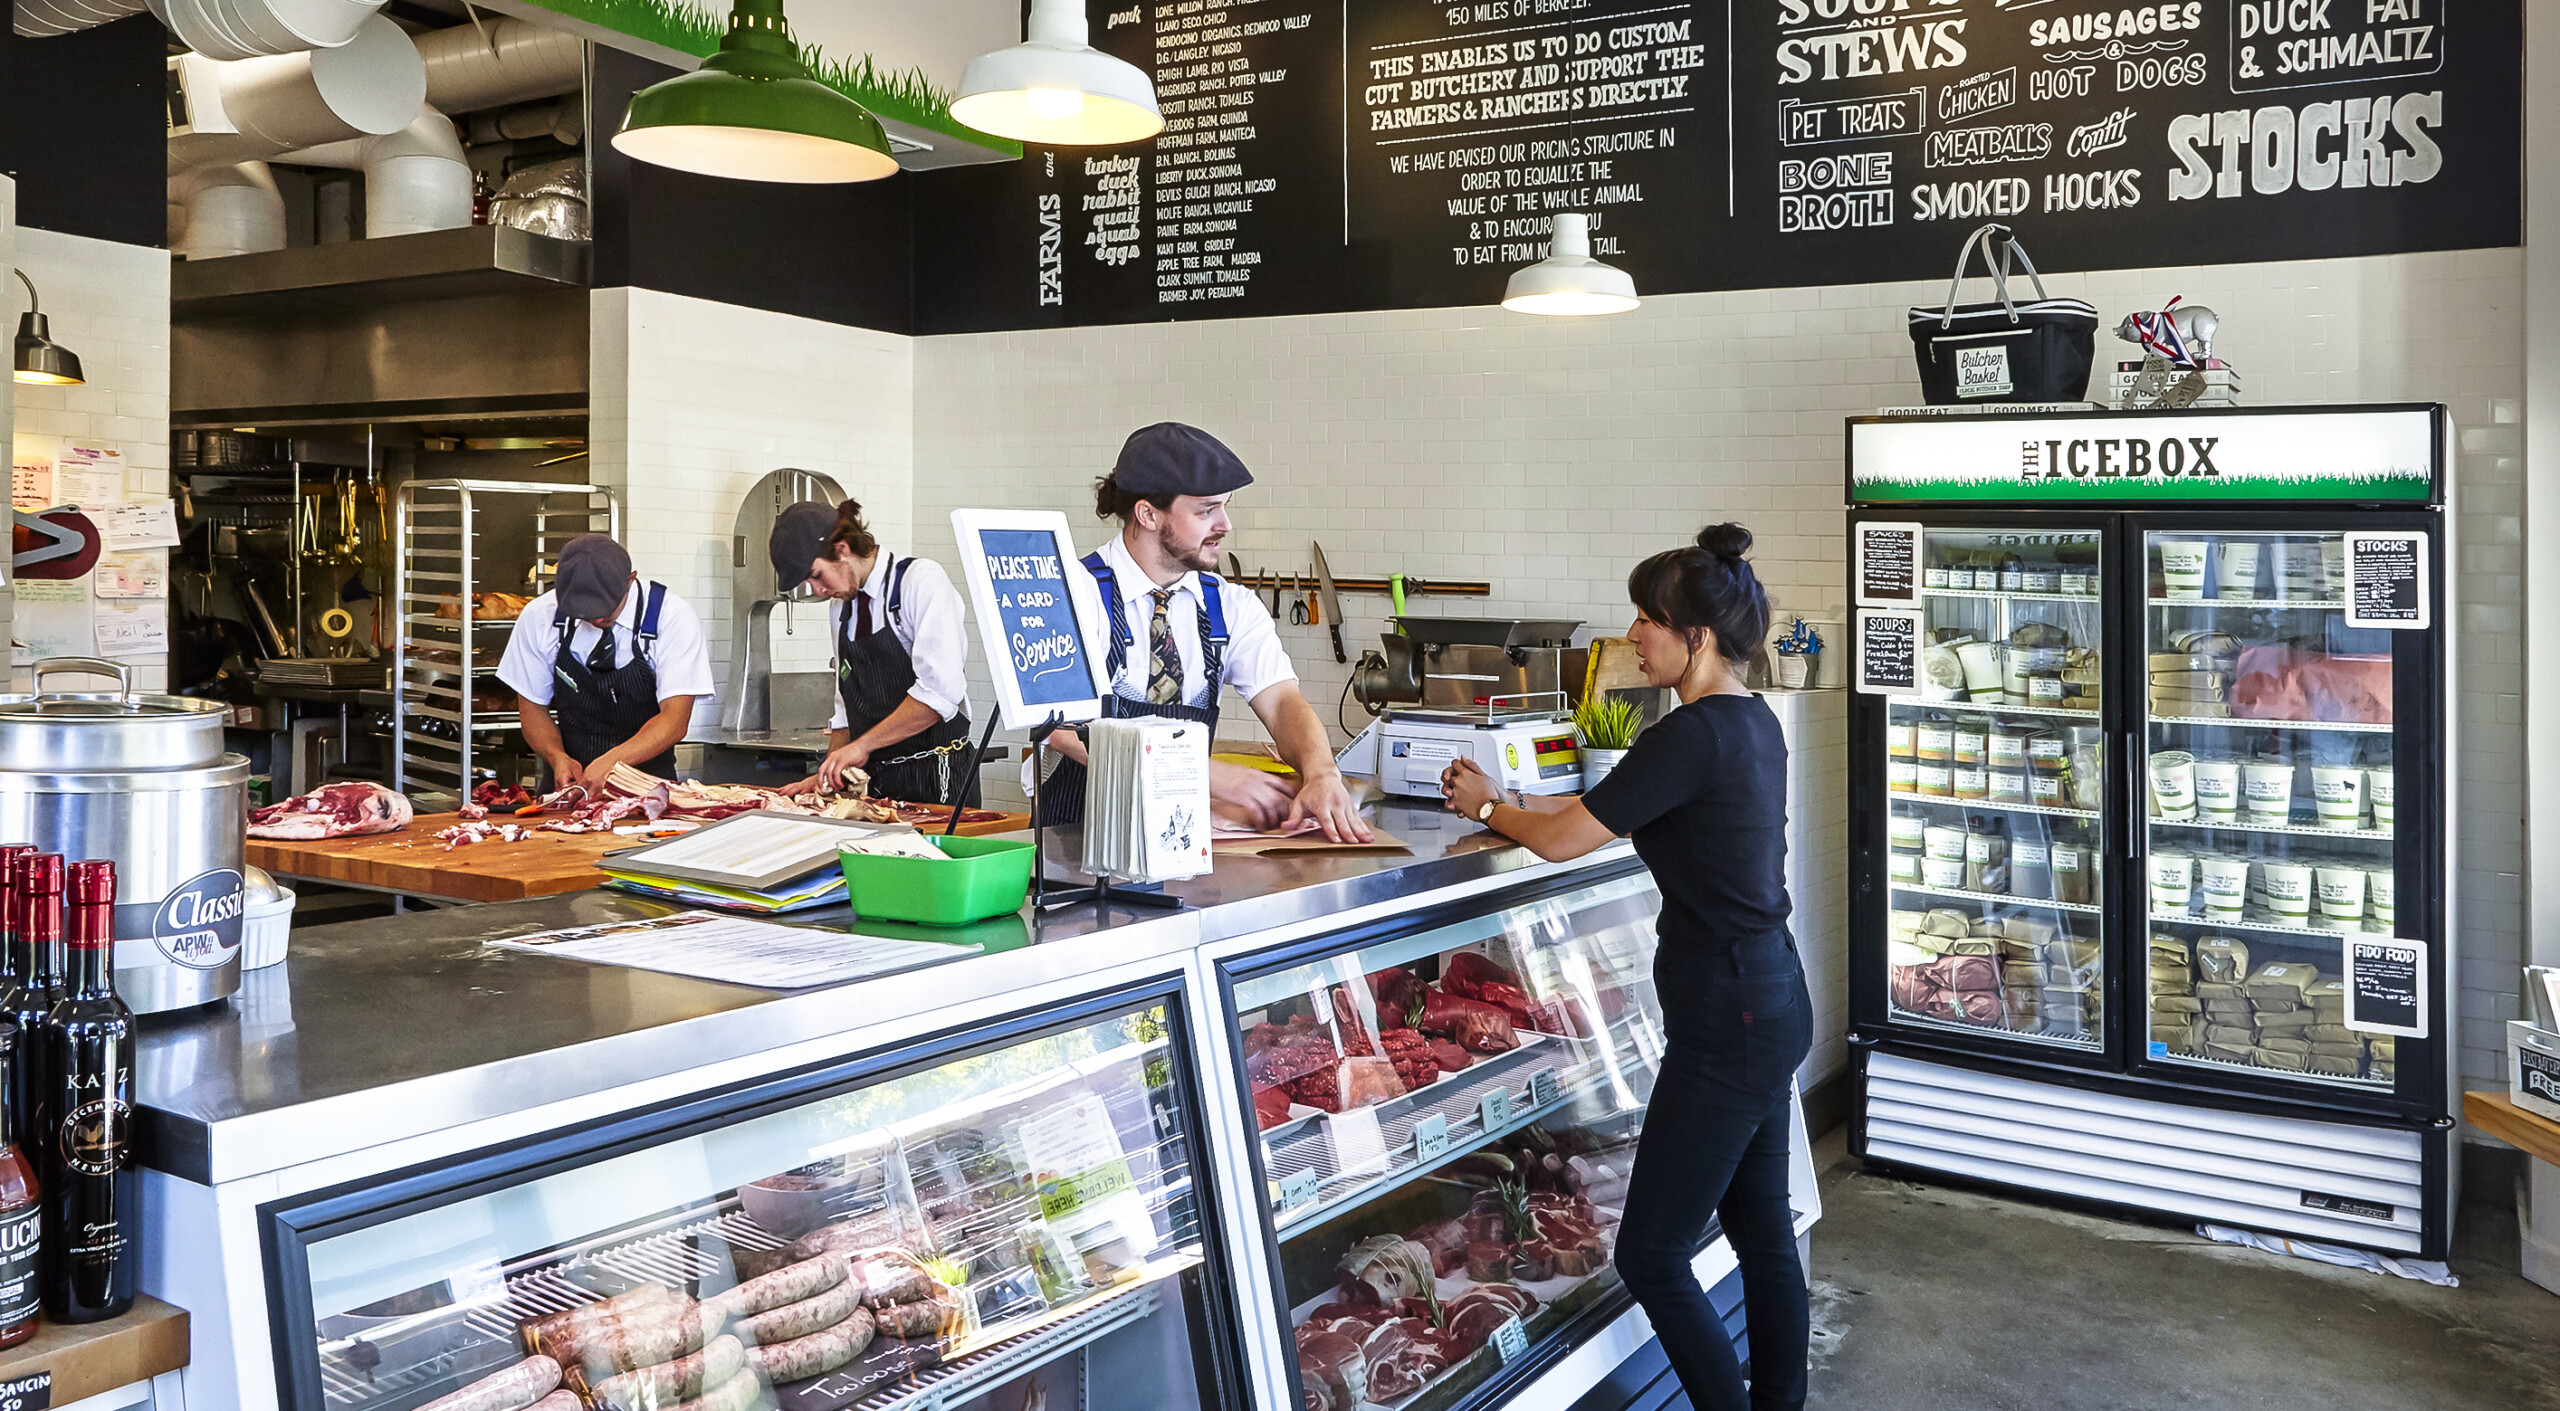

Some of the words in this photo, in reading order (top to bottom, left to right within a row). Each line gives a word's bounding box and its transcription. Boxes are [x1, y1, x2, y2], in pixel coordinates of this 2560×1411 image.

[1156, 6, 1174, 18] LONE
[1177, 2, 1203, 15] WILLOW
[1445, 7, 1470, 26] 150
[1474, 2, 1508, 22] MILES
[1514, 0, 1530, 18] OF
[1846, 14, 1897, 30] AND
[2240, 0, 2332, 40] DUCK
[1156, 20, 1180, 33] LLANO
[1156, 32, 1198, 48] MENDOCINO
[1244, 20, 1280, 36] REDWOOD
[1283, 14, 1312, 30] VALLEY
[2028, 3, 2202, 46] SAUSAGES
[1212, 42, 1242, 57] NICASIO
[1370, 56, 1414, 80] THIS
[1420, 43, 1508, 74] ENABLES
[1513, 39, 1536, 61] US
[1541, 35, 1568, 58] TO
[1574, 31, 1602, 56] DO
[1608, 19, 1692, 50] CUSTOM
[1776, 17, 1969, 85] STEWS
[2239, 46, 2264, 80] &
[2276, 26, 2435, 76] SCHMALTZ
[1157, 66, 1182, 82] EMIGH
[1212, 62, 1224, 74] RIO
[1228, 58, 1249, 72] VISTA
[1364, 84, 1404, 107] CUT
[1410, 68, 1516, 102] BUTCHERY
[1520, 64, 1560, 91] AND
[1564, 52, 1648, 84] SUPPORT
[1655, 44, 1705, 72] THE
[1960, 72, 1990, 89] ROASTED
[2030, 64, 2096, 101] HOT
[2116, 53, 2208, 92] DOGS
[1158, 81, 1196, 98] MAGRUDER
[1230, 74, 1256, 88] POTTER
[1258, 69, 1286, 84] VALLEY
[1218, 91, 1254, 108] TOMALES
[1370, 104, 1461, 132] FARMERS
[1462, 102, 1478, 121] &
[1480, 88, 1584, 120] RANCHERS
[1588, 75, 1689, 109] DIRECTLY.
[1938, 77, 2010, 122] CHICKEN
[1162, 118, 1194, 132] VERDOG
[1220, 110, 1248, 126] GUINDA
[1792, 108, 1827, 140] PET
[1837, 100, 1906, 136] TREATS
[1157, 134, 1194, 150] HOFFMAN
[1220, 126, 1256, 143] MANTECA
[1931, 124, 2052, 161] MEATBALLS
[2066, 106, 2139, 160] Confit
[1204, 147, 1236, 162] BOLINAS
[1390, 156, 1410, 174] WE
[1414, 152, 1446, 172] HAVE
[1448, 146, 1496, 168] DEVISED
[1500, 144, 1526, 164] OUR
[1531, 139, 1580, 161] PRICING
[1583, 130, 1654, 156] STRUCTURE
[1660, 127, 1675, 148] IN
[2167, 90, 2444, 202] STOCKS
[1044, 152, 1055, 178] and
[1084, 154, 1140, 176] turkey
[1156, 170, 1183, 184] LIBERTY
[1208, 164, 1242, 178] SONOMA
[1462, 170, 1501, 192] ORDER
[1504, 168, 1521, 188] TO
[1524, 163, 1584, 186] EQUALIZE
[1588, 160, 1613, 180] THE
[1778, 152, 1893, 194] BONE
[1098, 172, 1140, 192] duck
[1184, 185, 1210, 200] GULCH
[1244, 178, 1276, 194] NICASIO
[1082, 188, 1141, 211] rabbit
[1448, 197, 1486, 216] VALUE
[1490, 195, 1508, 214] OF
[1512, 193, 1538, 212] THE
[1542, 188, 1589, 210] WHOLE
[1594, 184, 1644, 206] ANIMAL
[1910, 177, 2031, 222] SMOKED
[2044, 168, 2142, 215] HOCKS
[1093, 206, 1140, 232] quail
[1156, 206, 1182, 220] WOLFE
[1212, 200, 1252, 214] VACAVILLE
[1778, 189, 1894, 233] BROTH
[1084, 224, 1140, 248] squab
[1157, 224, 1180, 238] PAINE
[1204, 219, 1237, 233] SONOMA
[1470, 223, 1482, 240] &
[1484, 220, 1499, 239] TO
[1504, 216, 1553, 237] ENCOUR
[1588, 212, 1602, 232] OU
[1038, 194, 1062, 306] FARMS
[1095, 244, 1140, 266] eggs
[1156, 243, 1174, 256] KAKI
[1204, 238, 1234, 252] GRIDLEY
[1453, 246, 1469, 266] TO
[1474, 245, 1498, 264] EAT
[1501, 242, 1534, 263] FROM
[1594, 236, 1626, 256] TAIL.
[1156, 258, 1180, 272] APPLE
[1182, 256, 1200, 269] TREE
[1231, 252, 1262, 266] MADERA
[1157, 274, 1181, 288] CLARK
[1216, 268, 1250, 282] TOMALES
[1159, 290, 1188, 303] FARMER
[1208, 286, 1244, 299] PETALUMA
[1960, 351, 2004, 369] Butcher
[1964, 366, 2000, 385] Basket
[1994, 405, 2058, 414] GOODMEAT
[2022, 440, 2040, 480] THE
[2045, 436, 2220, 479] ICEBOX
[2356, 540, 2408, 552] STOCKS
[986, 556, 1034, 580] PLEASE
[1030, 556, 1062, 580] TAKE
[1016, 592, 1054, 608] CARD
[1020, 616, 1046, 628] FOR
[1869, 618, 1907, 632] SOUPS
[1012, 628, 1076, 672] Service
[168, 882, 244, 929] Classic
[172, 934, 208, 954] APW
[2386, 948, 2416, 963] FOOD
[66, 1067, 128, 1090] KAZ
[2532, 1073, 2560, 1097] FREE
[66, 1102, 130, 1127] DECEMER'S
[71, 1157, 102, 1173] NEW
[0, 1213, 40, 1252] UCIN
[0, 1376, 51, 1400] SAUCIN
